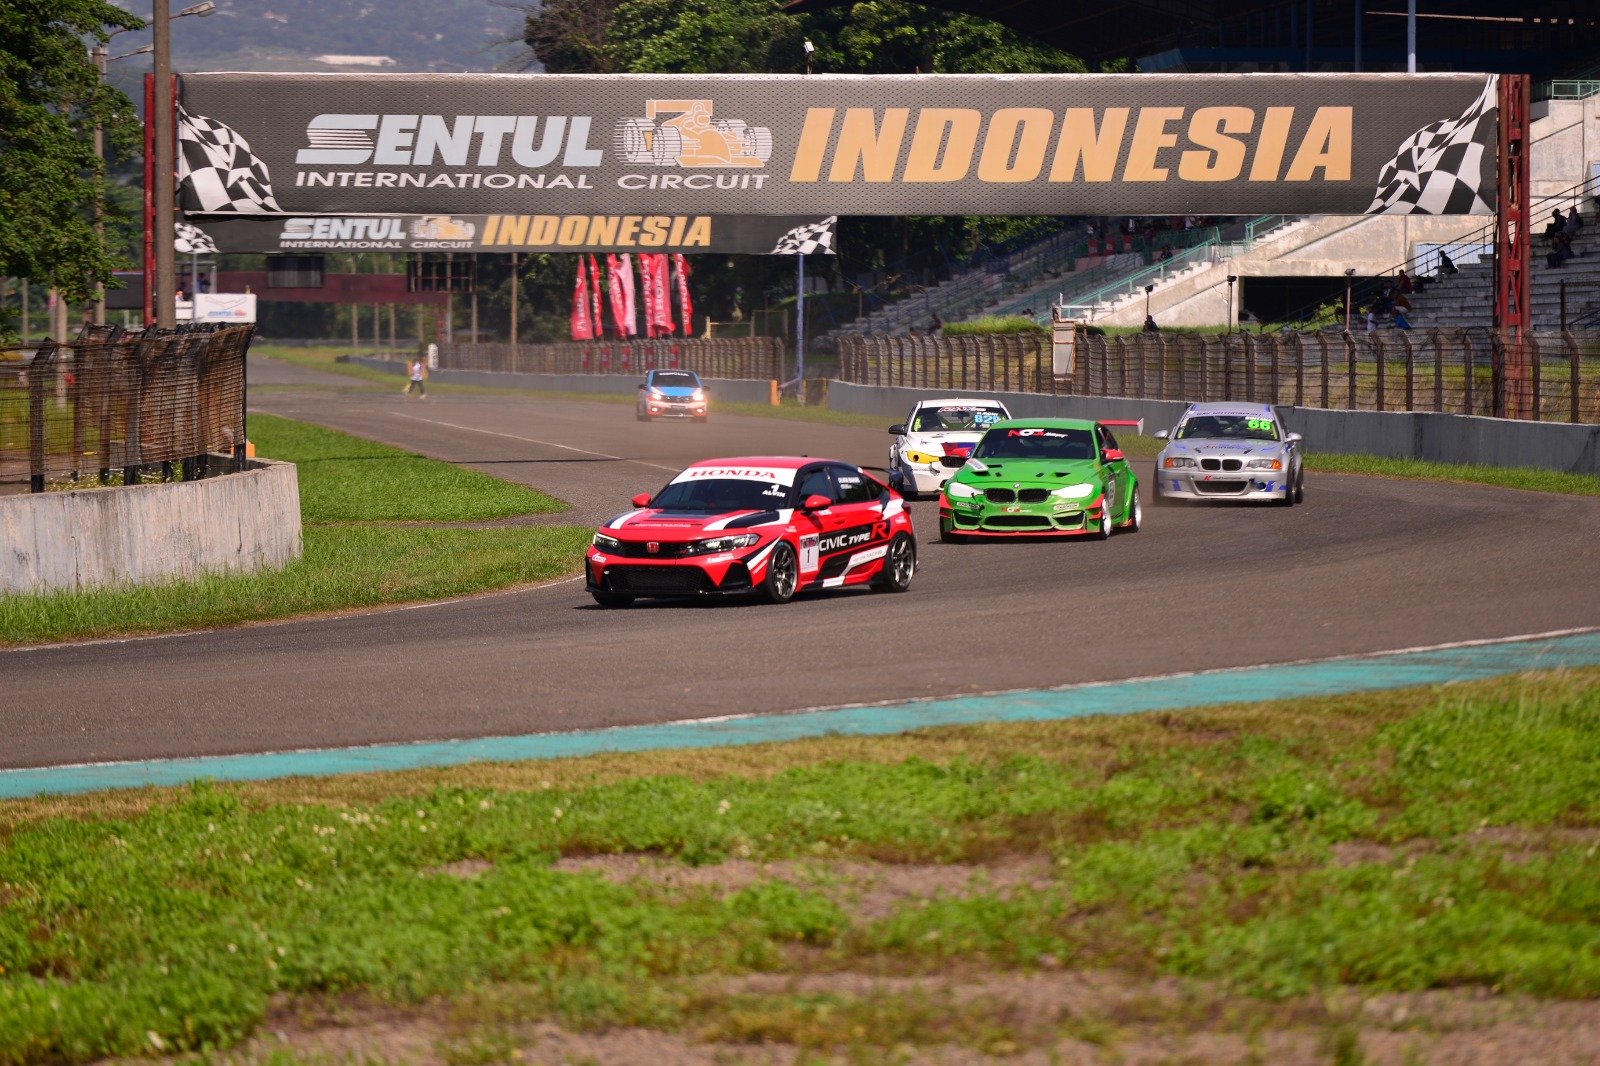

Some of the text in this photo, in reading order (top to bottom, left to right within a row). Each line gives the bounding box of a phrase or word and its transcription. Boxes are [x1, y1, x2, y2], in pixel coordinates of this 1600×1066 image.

[295, 113, 604, 168] SENTUL
[790, 106, 1353, 183] INDONESIA
[295, 172, 770, 191] INTERNATIONAL CIRCUIT
[279, 214, 711, 246] SENTUL INDONESIA
[280, 240, 475, 250] INTERNATIONAL CIRCUIT
[1247, 419, 1271, 431] 66
[691, 469, 777, 479] HONDA
[762, 489, 786, 498] ALVIN
[770, 484, 780, 493] 1
[820, 534, 847, 551] CIVIC
[849, 532, 870, 544] TYPE
[871, 522, 888, 540] R
